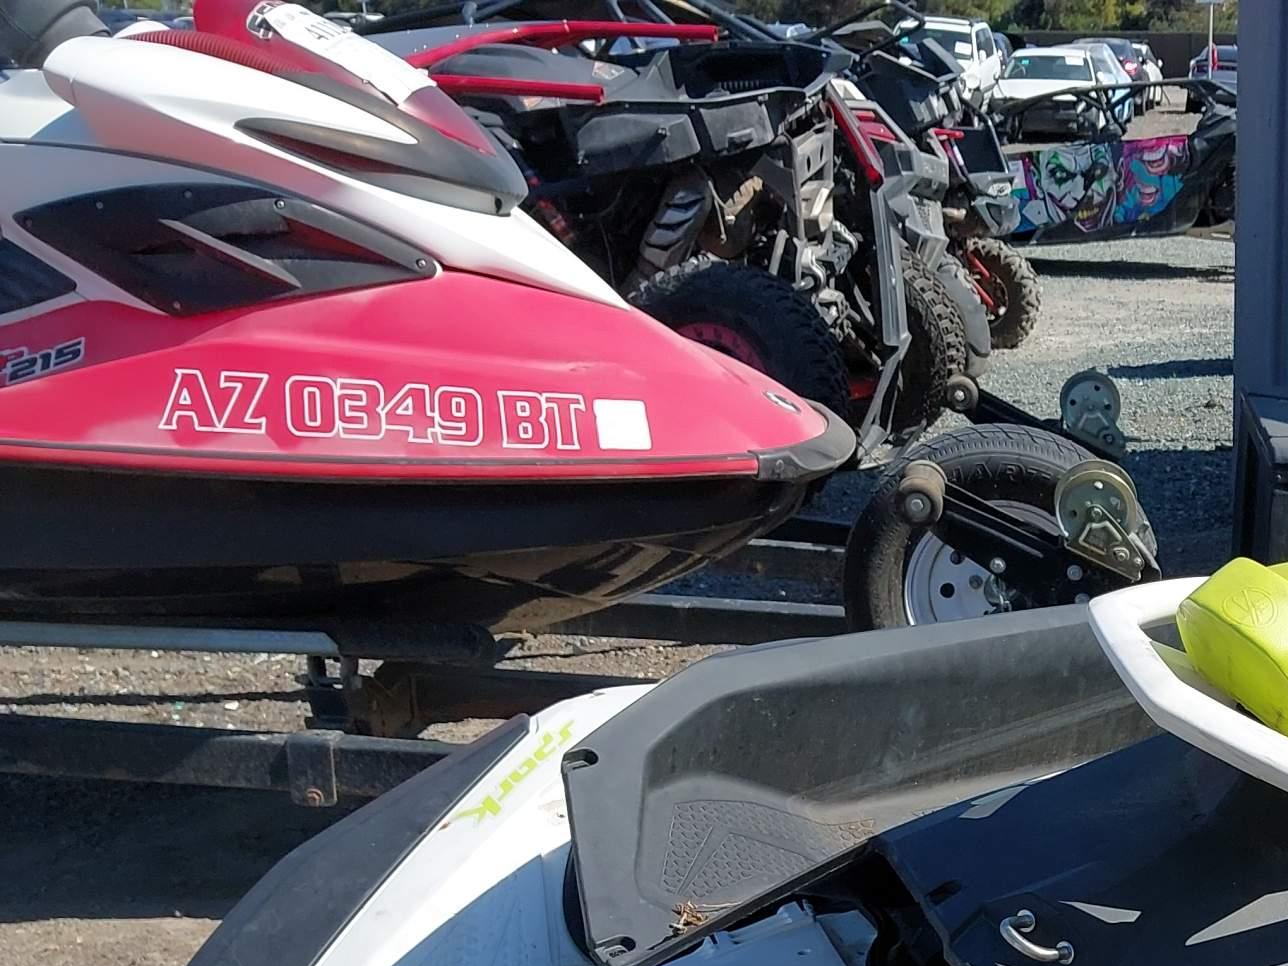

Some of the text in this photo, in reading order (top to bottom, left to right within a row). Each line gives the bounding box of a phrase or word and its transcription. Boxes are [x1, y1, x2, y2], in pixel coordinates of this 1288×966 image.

[6, 337, 86, 385] 215
[158, 368, 586, 451] AZ 0349 BT
